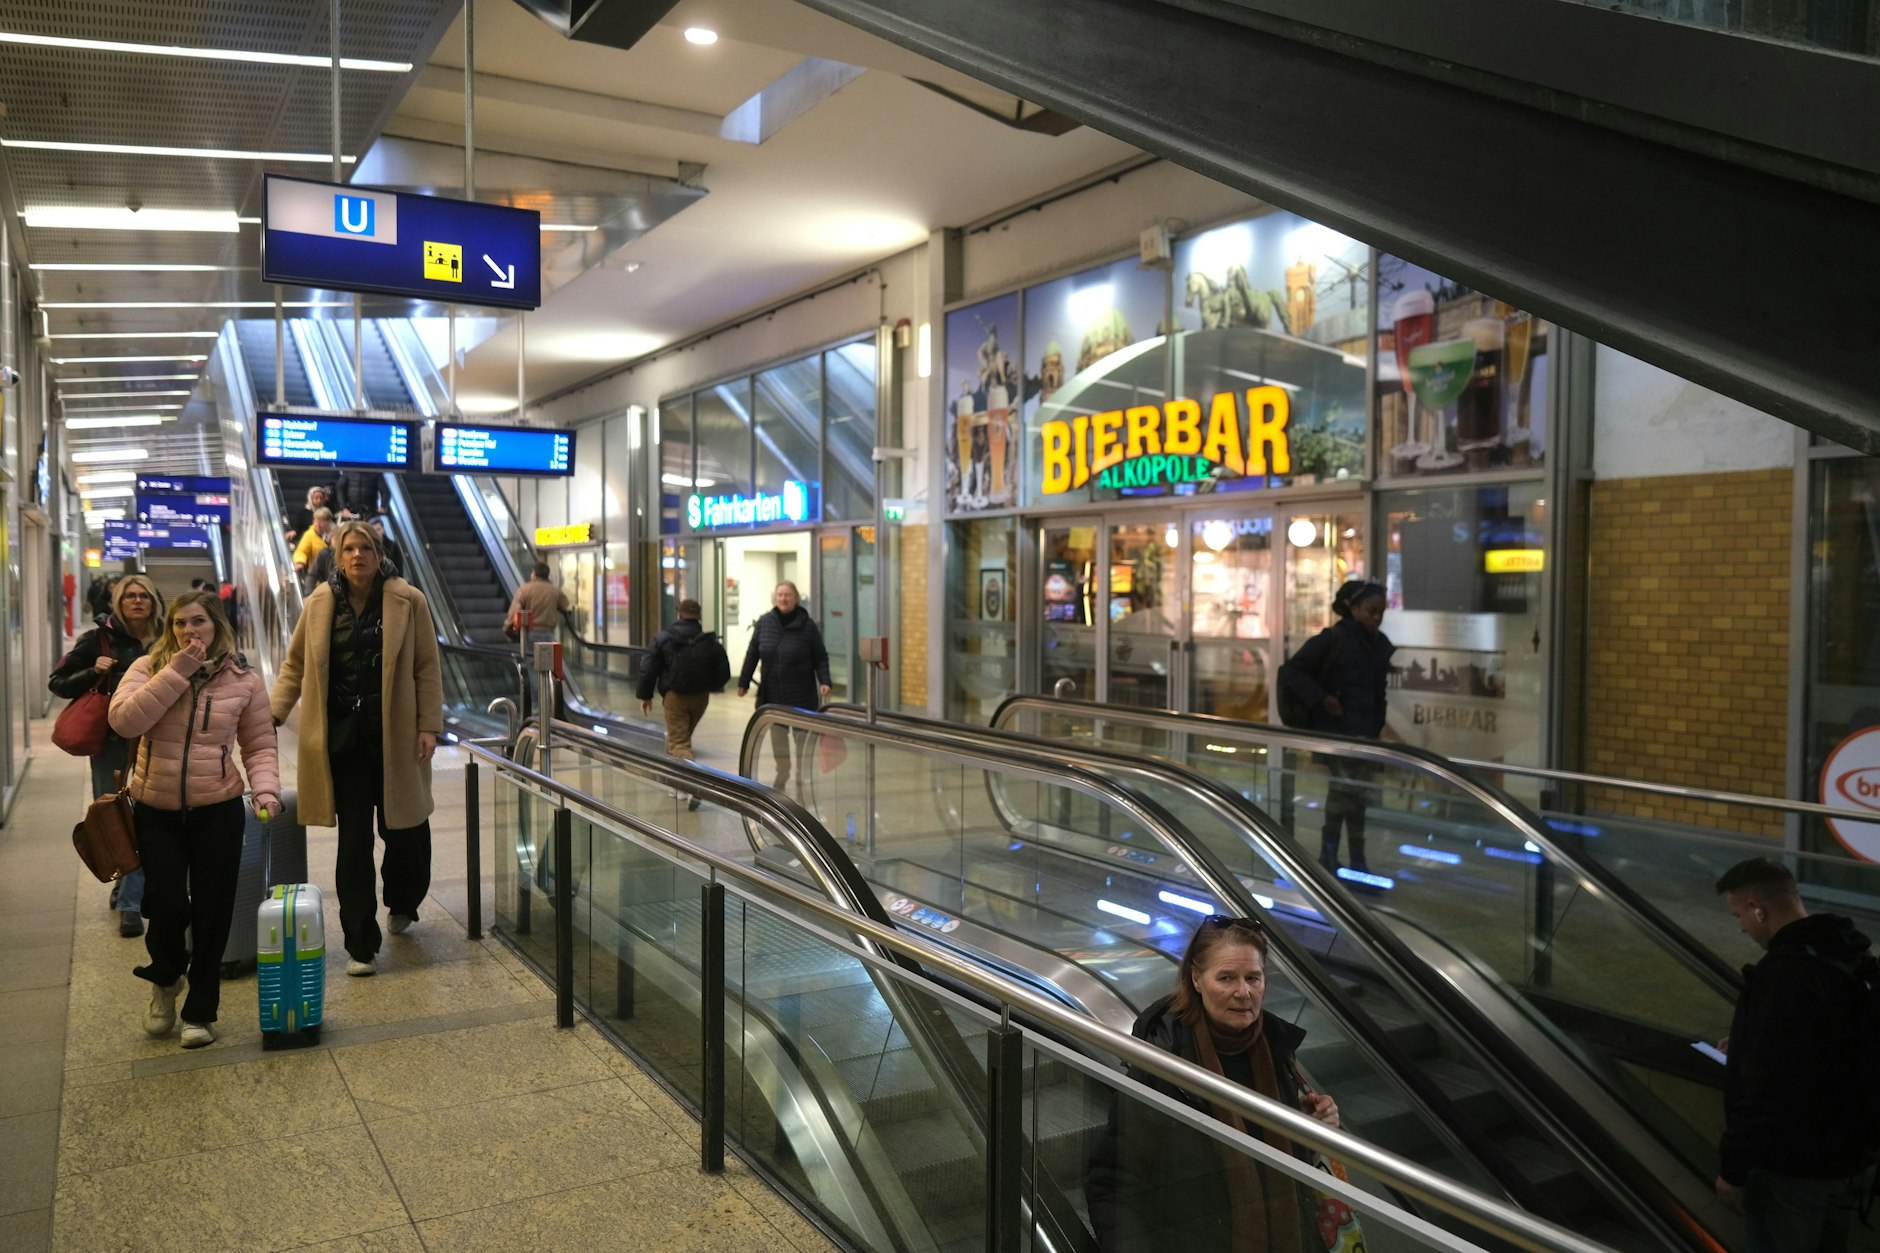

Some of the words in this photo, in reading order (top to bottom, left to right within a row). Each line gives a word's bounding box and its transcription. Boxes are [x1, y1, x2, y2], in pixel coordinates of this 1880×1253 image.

[341, 197, 368, 233] U
[1041, 386, 1291, 495] BIERBAR
[1099, 453, 1211, 489] ALKOPOLE
[687, 494, 702, 528] S
[704, 491, 782, 527] Fahrkarten
[1413, 703, 1497, 734] BIERBAR
